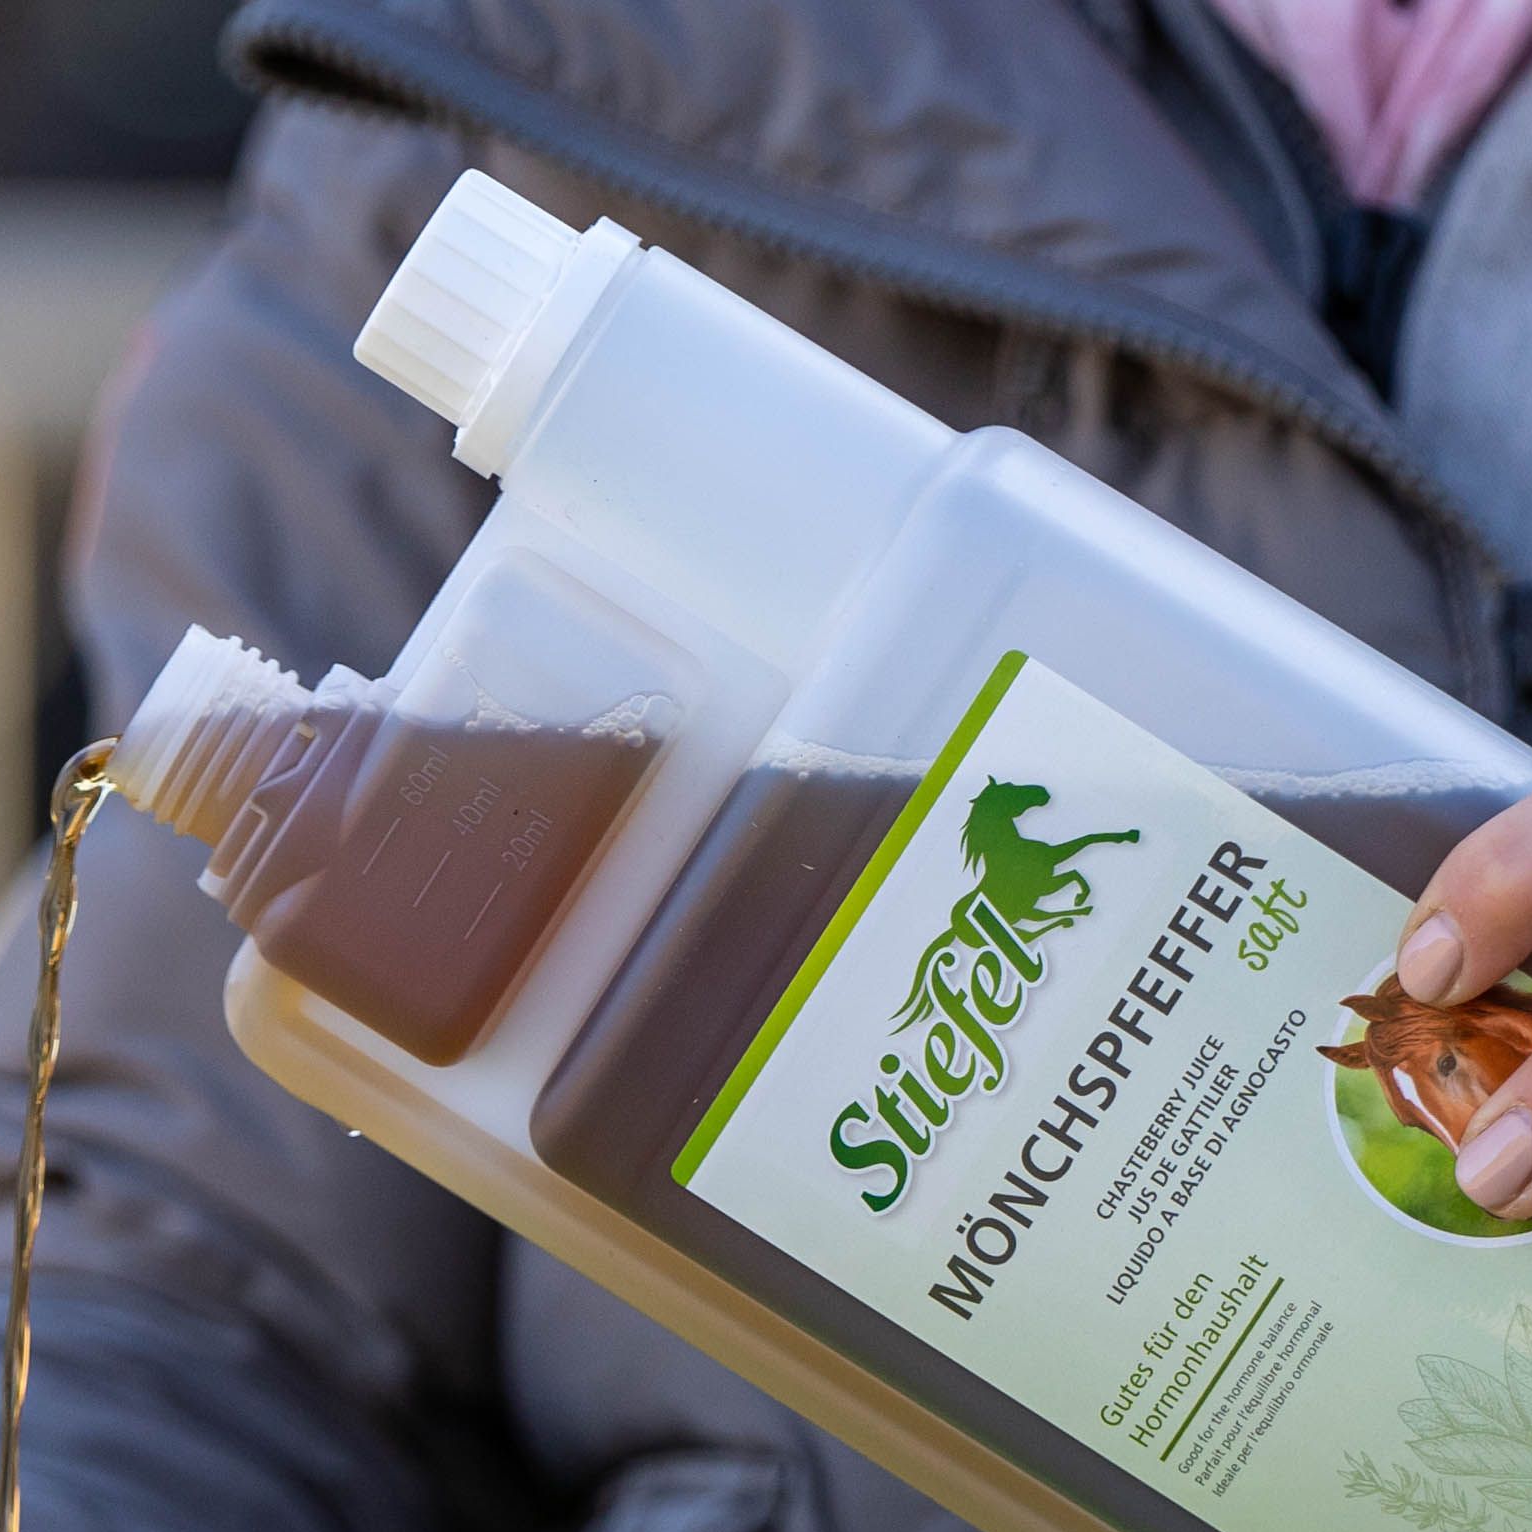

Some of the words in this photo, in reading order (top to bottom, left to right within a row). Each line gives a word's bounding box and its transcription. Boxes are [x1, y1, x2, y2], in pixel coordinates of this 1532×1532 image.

[399, 744, 450, 806] 60ml
[452, 776, 502, 836] 40ml
[501, 808, 553, 872] 20ml
[1238, 878, 1308, 972] saft
[828, 893, 1046, 1213] Stiefel
[928, 841, 1269, 1321] MÖNCHSPFEFFER
[1096, 1087, 1189, 1221] CHASTEBERRY
[1181, 1034, 1225, 1090] JUICE
[1106, 1226, 1165, 1306] LIQUIDO
[1159, 1208, 1180, 1228] A
[1171, 1156, 1213, 1209] BASE
[1204, 1131, 1228, 1157] DI
[1222, 1008, 1307, 1134] AGNOCASTO
[1127, 1188, 1159, 1225] JUS
[1150, 1156, 1179, 1188] DE
[1171, 1063, 1240, 1158] GATTILIER
[1100, 1362, 1154, 1427] Gutes
[1143, 1321, 1179, 1360] für
[1174, 1271, 1214, 1321] den
[1128, 1253, 1269, 1448] Hormonhaushalt
[1177, 1442, 1204, 1474] Good
[1198, 1425, 1215, 1443] for
[1211, 1405, 1231, 1426] the
[1226, 1350, 1266, 1404] hormone
[1259, 1301, 1298, 1350] balance
[1194, 1446, 1227, 1487] Parfait
[1221, 1420, 1243, 1450] pour
[1277, 1299, 1323, 1363] hormonal
[1212, 1463, 1241, 1497] Ideale
[1237, 1443, 1253, 1465] per
[1292, 1320, 1335, 1381] ormonale
